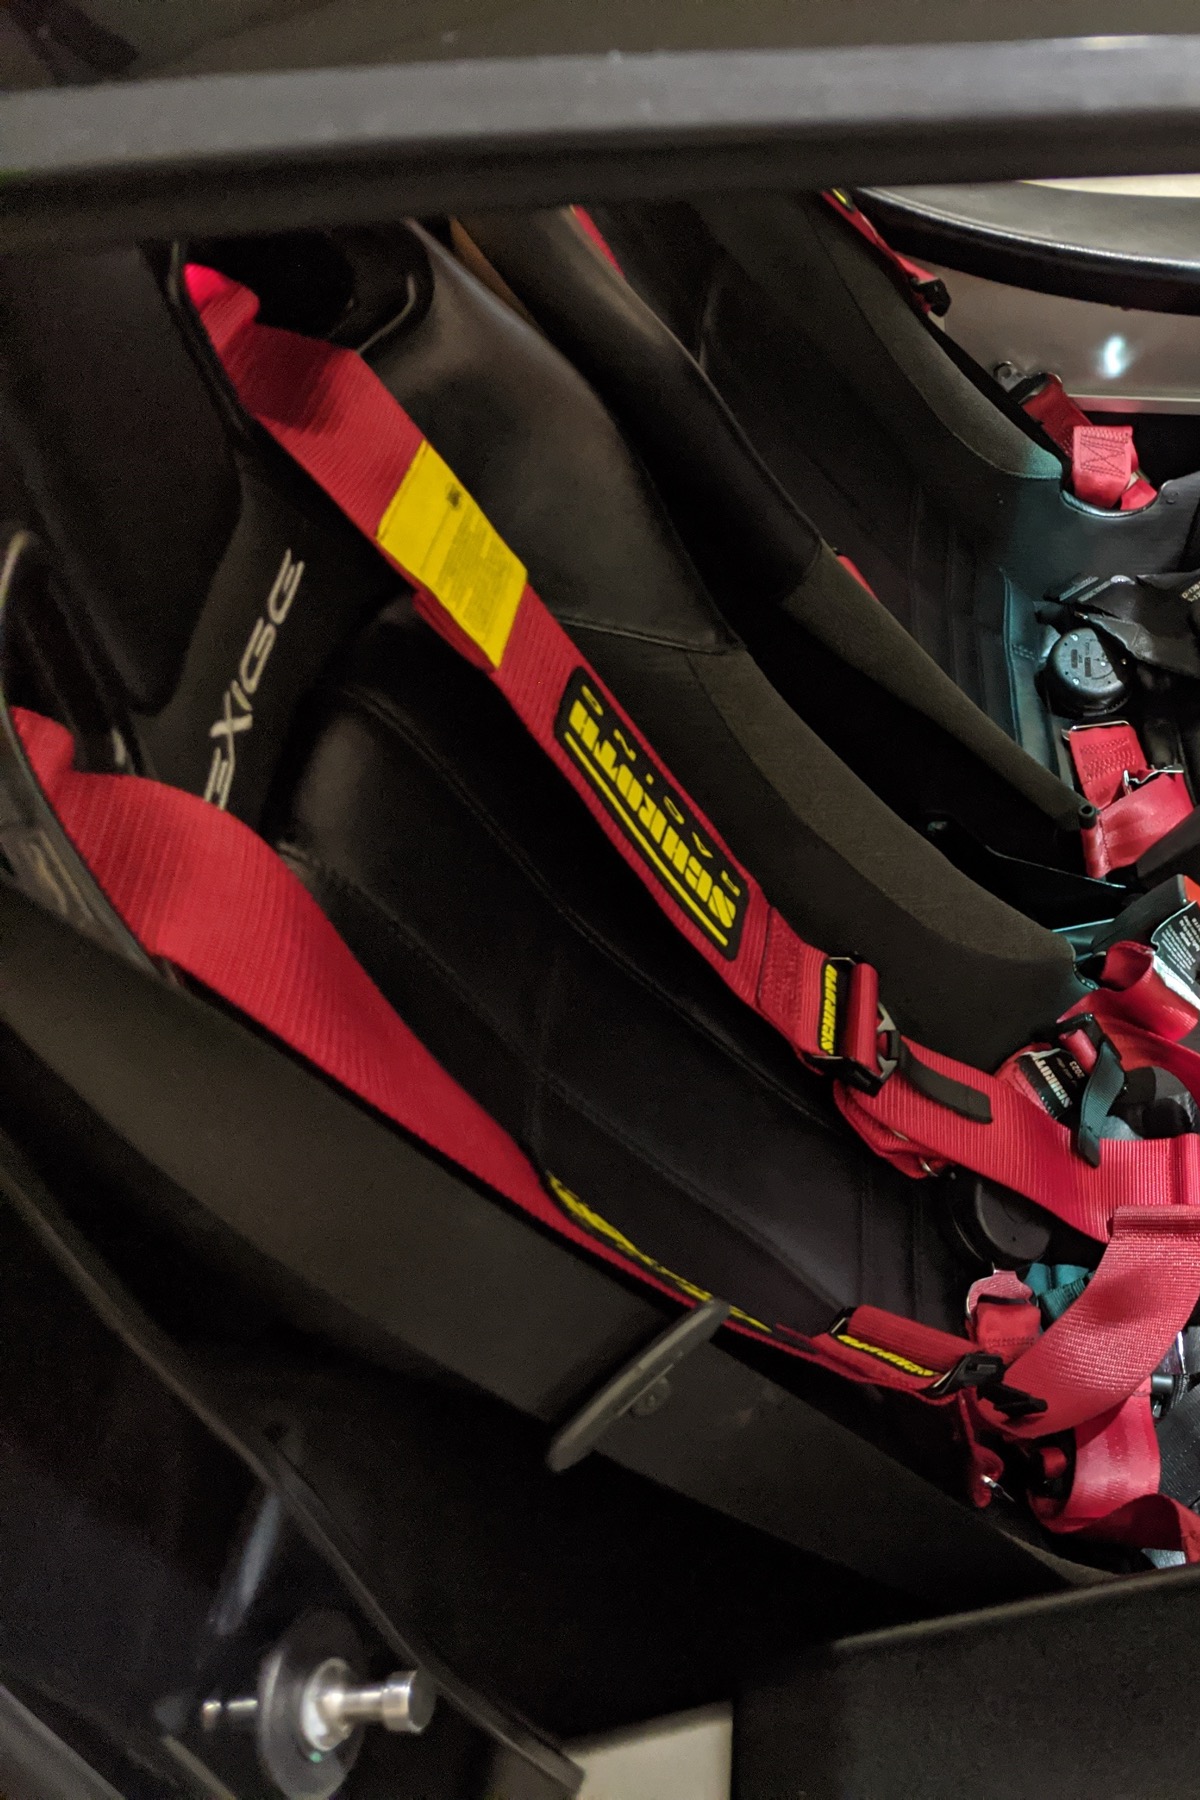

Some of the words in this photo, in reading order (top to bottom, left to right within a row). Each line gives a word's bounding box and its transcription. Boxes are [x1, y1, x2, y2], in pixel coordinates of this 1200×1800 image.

[204, 549, 305, 811] EXIGE
[581, 684, 741, 897] RACING
[568, 699, 737, 929] SCHROTH
